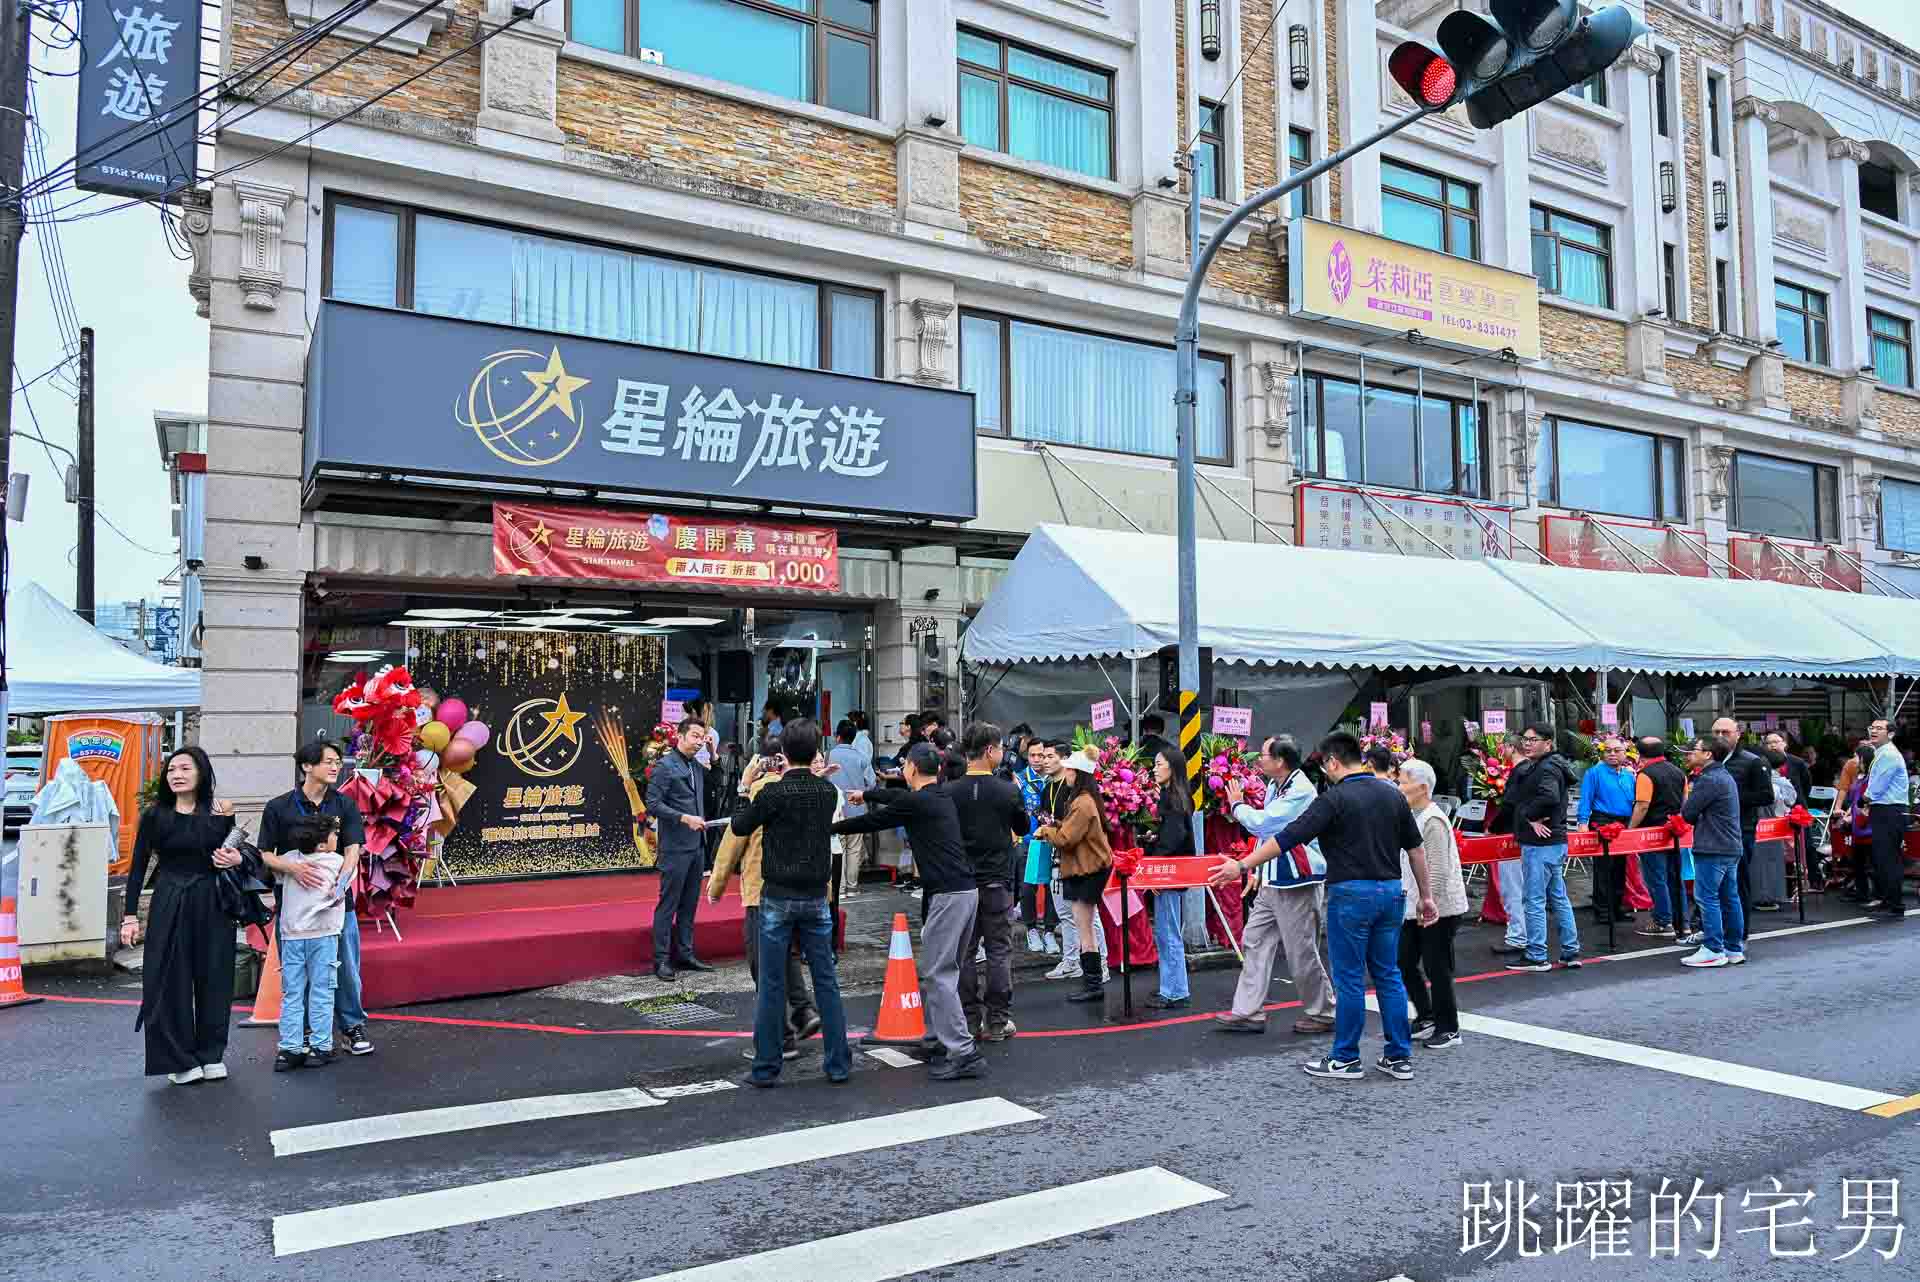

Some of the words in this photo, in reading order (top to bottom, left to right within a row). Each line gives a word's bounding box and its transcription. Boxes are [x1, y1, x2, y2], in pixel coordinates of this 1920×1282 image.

[96, 0, 182, 124] 旅遊
[101, 165, 128, 177] STAR
[130, 169, 168, 184] TRAVEL
[600, 377, 889, 487] 星綸旅遊
[564, 527, 651, 557] 星綸旅遊
[674, 526, 756, 553] 慶開幕
[766, 559, 825, 585] 1,000
[502, 784, 586, 813] 星綸旅遊
[900, 992, 922, 1008] KD
